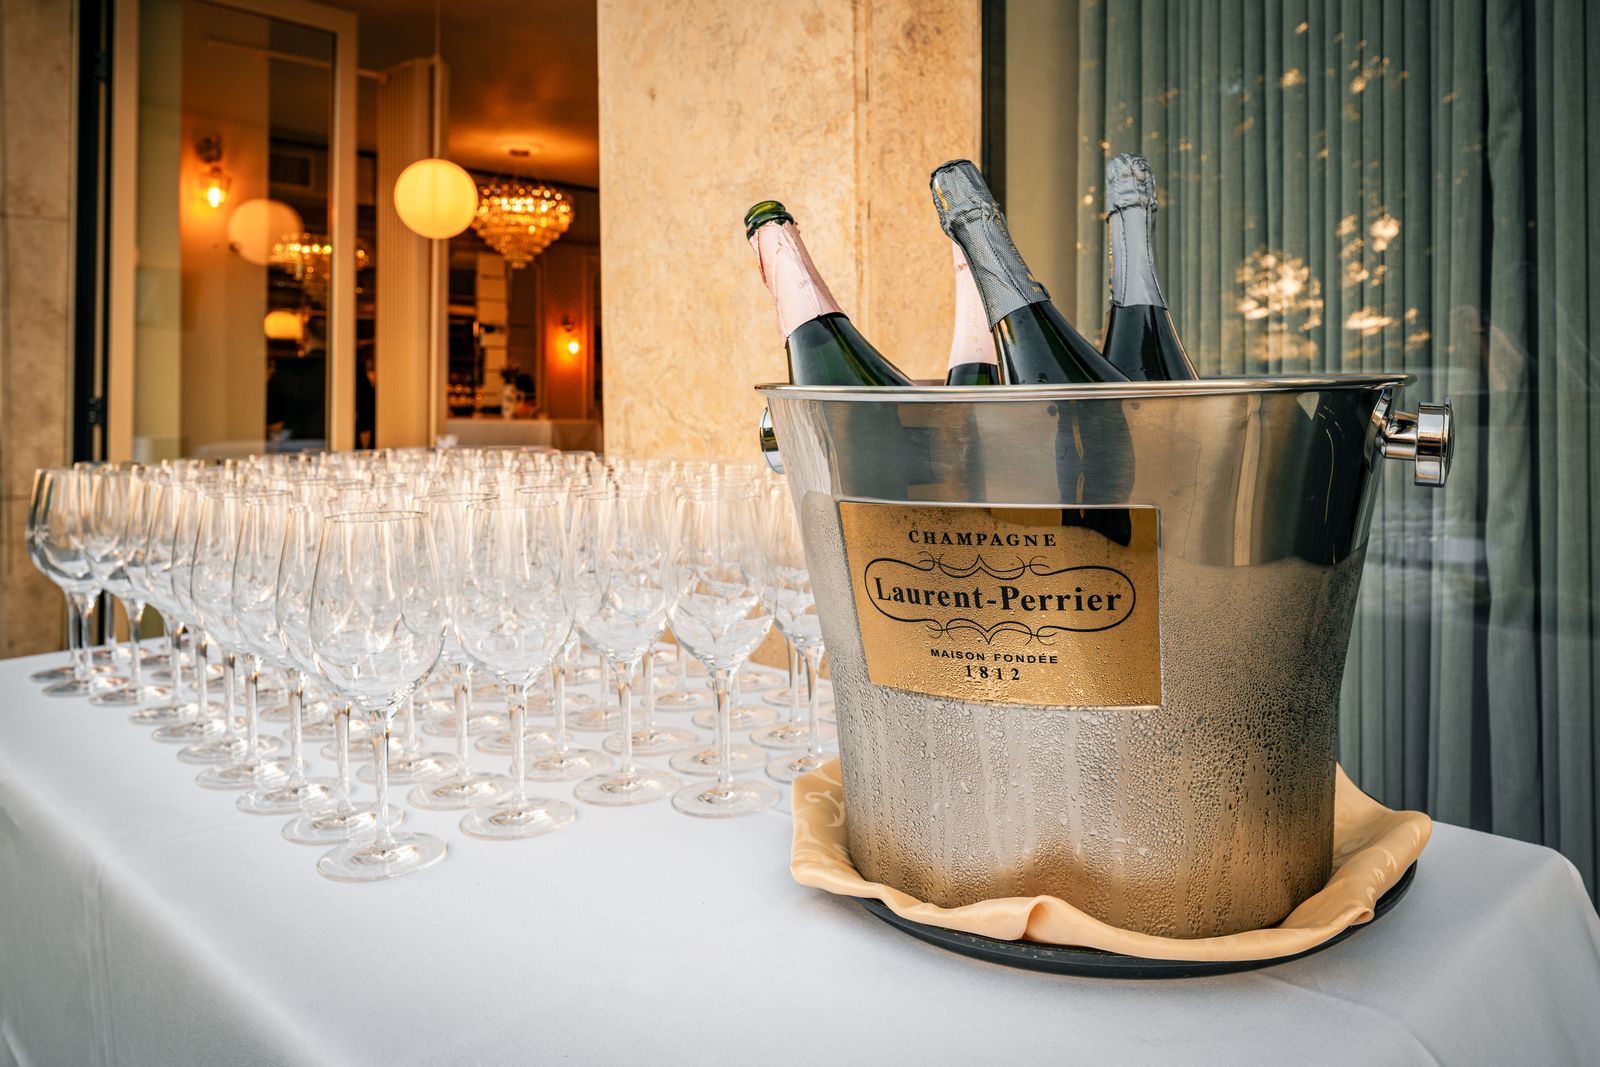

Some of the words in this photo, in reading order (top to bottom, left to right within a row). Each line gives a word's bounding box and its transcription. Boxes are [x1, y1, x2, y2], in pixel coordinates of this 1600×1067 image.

[908, 529, 1056, 548] CHAMPAGNE
[875, 577, 1122, 612] Laurent-Perrier
[930, 648, 985, 661] MAISON
[994, 653, 1058, 664] FONDÉE
[964, 664, 1021, 681] 1812
